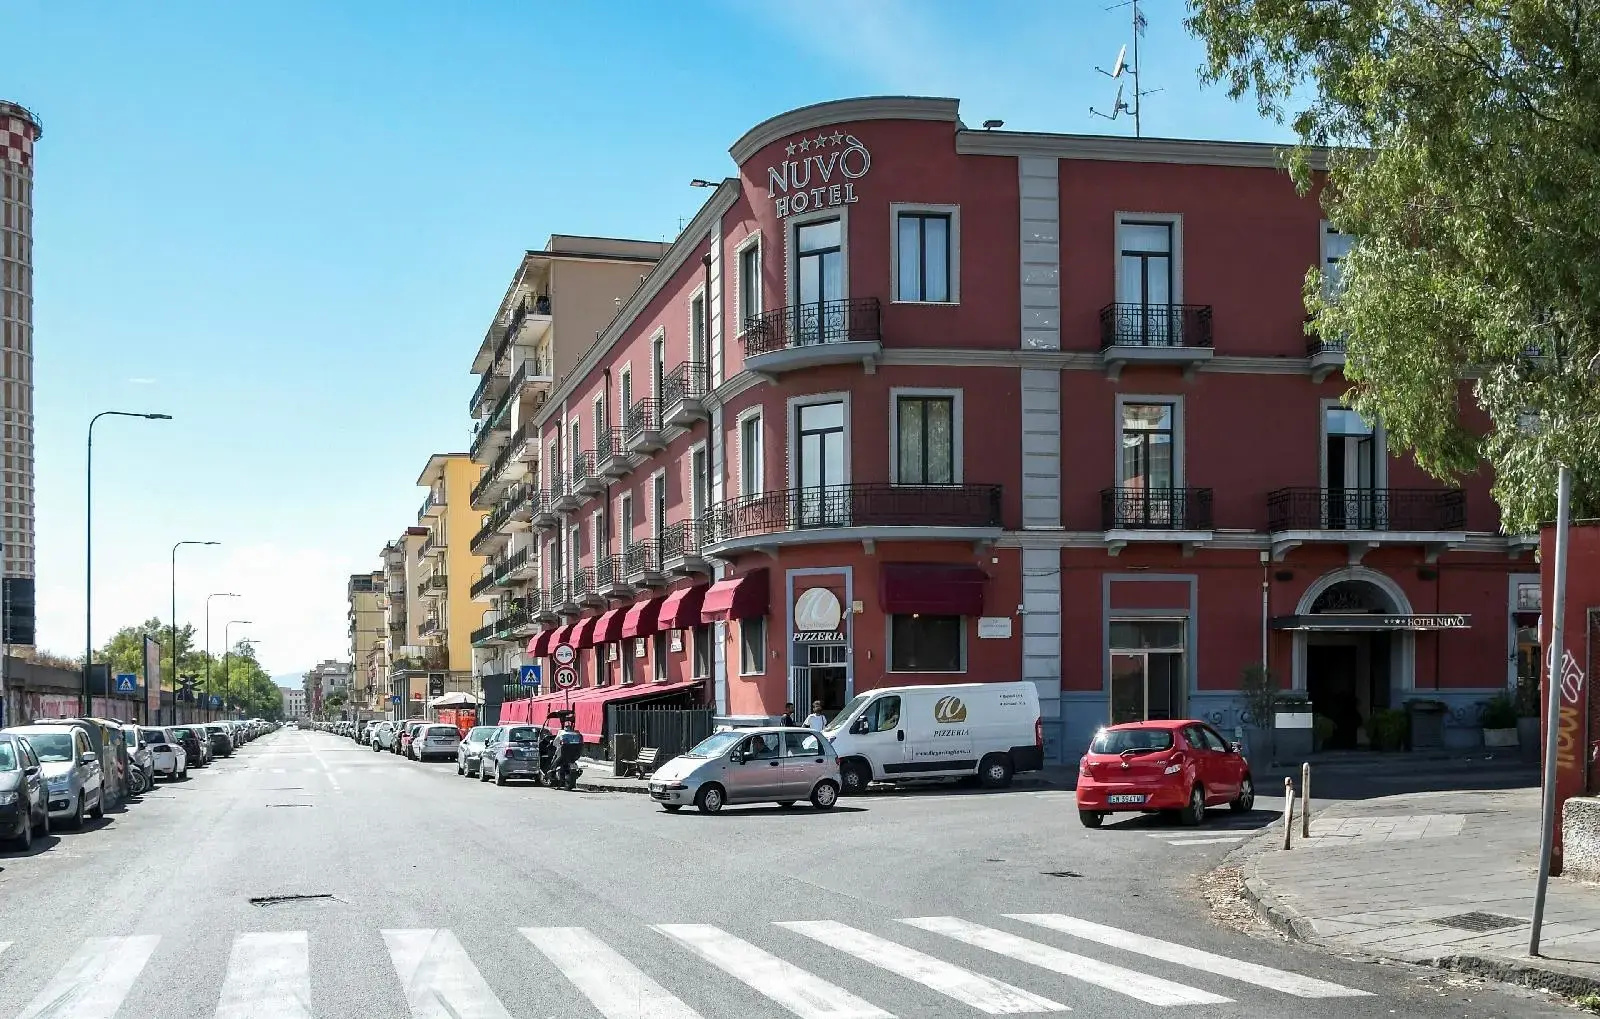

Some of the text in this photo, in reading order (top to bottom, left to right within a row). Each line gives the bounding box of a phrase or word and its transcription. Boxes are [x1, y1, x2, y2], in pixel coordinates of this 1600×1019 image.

[767, 135, 871, 199] NUVÒ
[775, 182, 859, 218] HOTEL
[1407, 617, 1436, 627] HOTEL
[792, 632, 845, 641] PIZZERIA
[559, 673, 573, 684] 30
[933, 729, 969, 738] PIZZERIA
